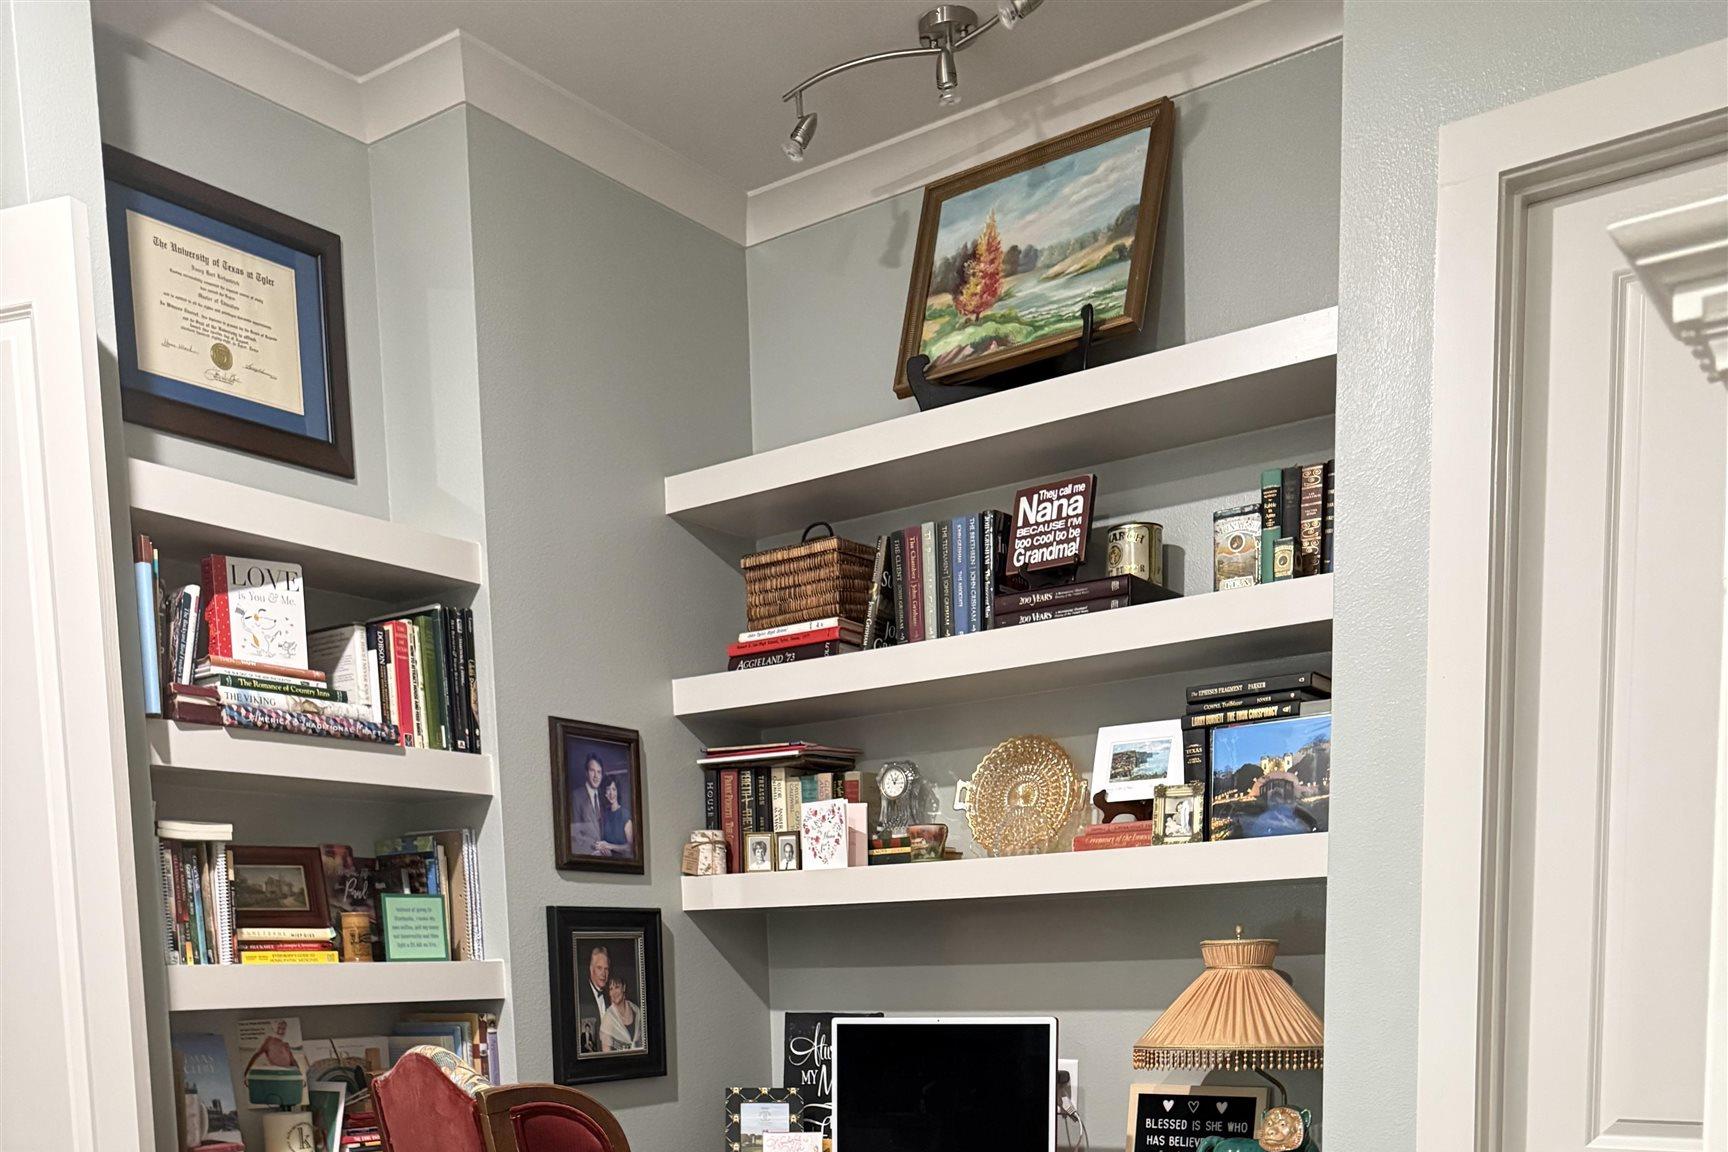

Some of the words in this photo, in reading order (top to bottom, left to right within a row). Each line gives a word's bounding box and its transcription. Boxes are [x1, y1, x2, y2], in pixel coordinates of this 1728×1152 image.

[153, 236, 168, 249] The
[170, 241, 210, 265] University
[212, 258, 220, 268] of
[222, 260, 244, 276] Texas
[255, 272, 275, 287] Tyler
[1039, 489, 1058, 501] They
[1059, 484, 1073, 496] call
[1073, 483, 1086, 493] me
[1017, 493, 1084, 527] Nana
[1016, 520, 1066, 538] BECAUSE
[1068, 516, 1082, 527] I'M
[1015, 538, 1032, 550] too
[1033, 531, 1055, 545] cool
[1055, 530, 1067, 540] to
[1068, 527, 1080, 538] be
[1013, 537, 1080, 567] Grandma!
[910, 551, 918, 579] Chamber
[231, 564, 300, 592] LOVE
[248, 591, 266, 603] You
[268, 592, 279, 603] &
[1018, 596, 1032, 606] 200
[1030, 592, 1053, 606] YEARS
[1018, 615, 1032, 624] 200
[1031, 612, 1053, 623] YEARS
[377, 630, 386, 665] DOBSON
[736, 654, 784, 671] AGGIELAND
[784, 652, 796, 662] '73
[238, 678, 251, 687] The
[252, 680, 282, 692] Romance
[282, 683, 290, 692] of
[290, 684, 316, 697] Country
[316, 688, 330, 698] Inns
[1218, 684, 1243, 694] FRAGMENT
[225, 691, 243, 702] THE
[243, 693, 276, 707] VIKING
[1248, 705, 1279, 719] CONSPIRACY
[706, 782, 714, 817] HOUSE
[801, 1069, 818, 1085] MY
[1145, 1118, 1187, 1130] BLESSED
[1192, 1120, 1201, 1131] IS
[1205, 1120, 1223, 1132] SHE
[1227, 1121, 1248, 1133] WHO
[297, 1126, 312, 1150] k
[1146, 1135, 1165, 1146] HAS
[1168, 1136, 1202, 1148] BELIEV
